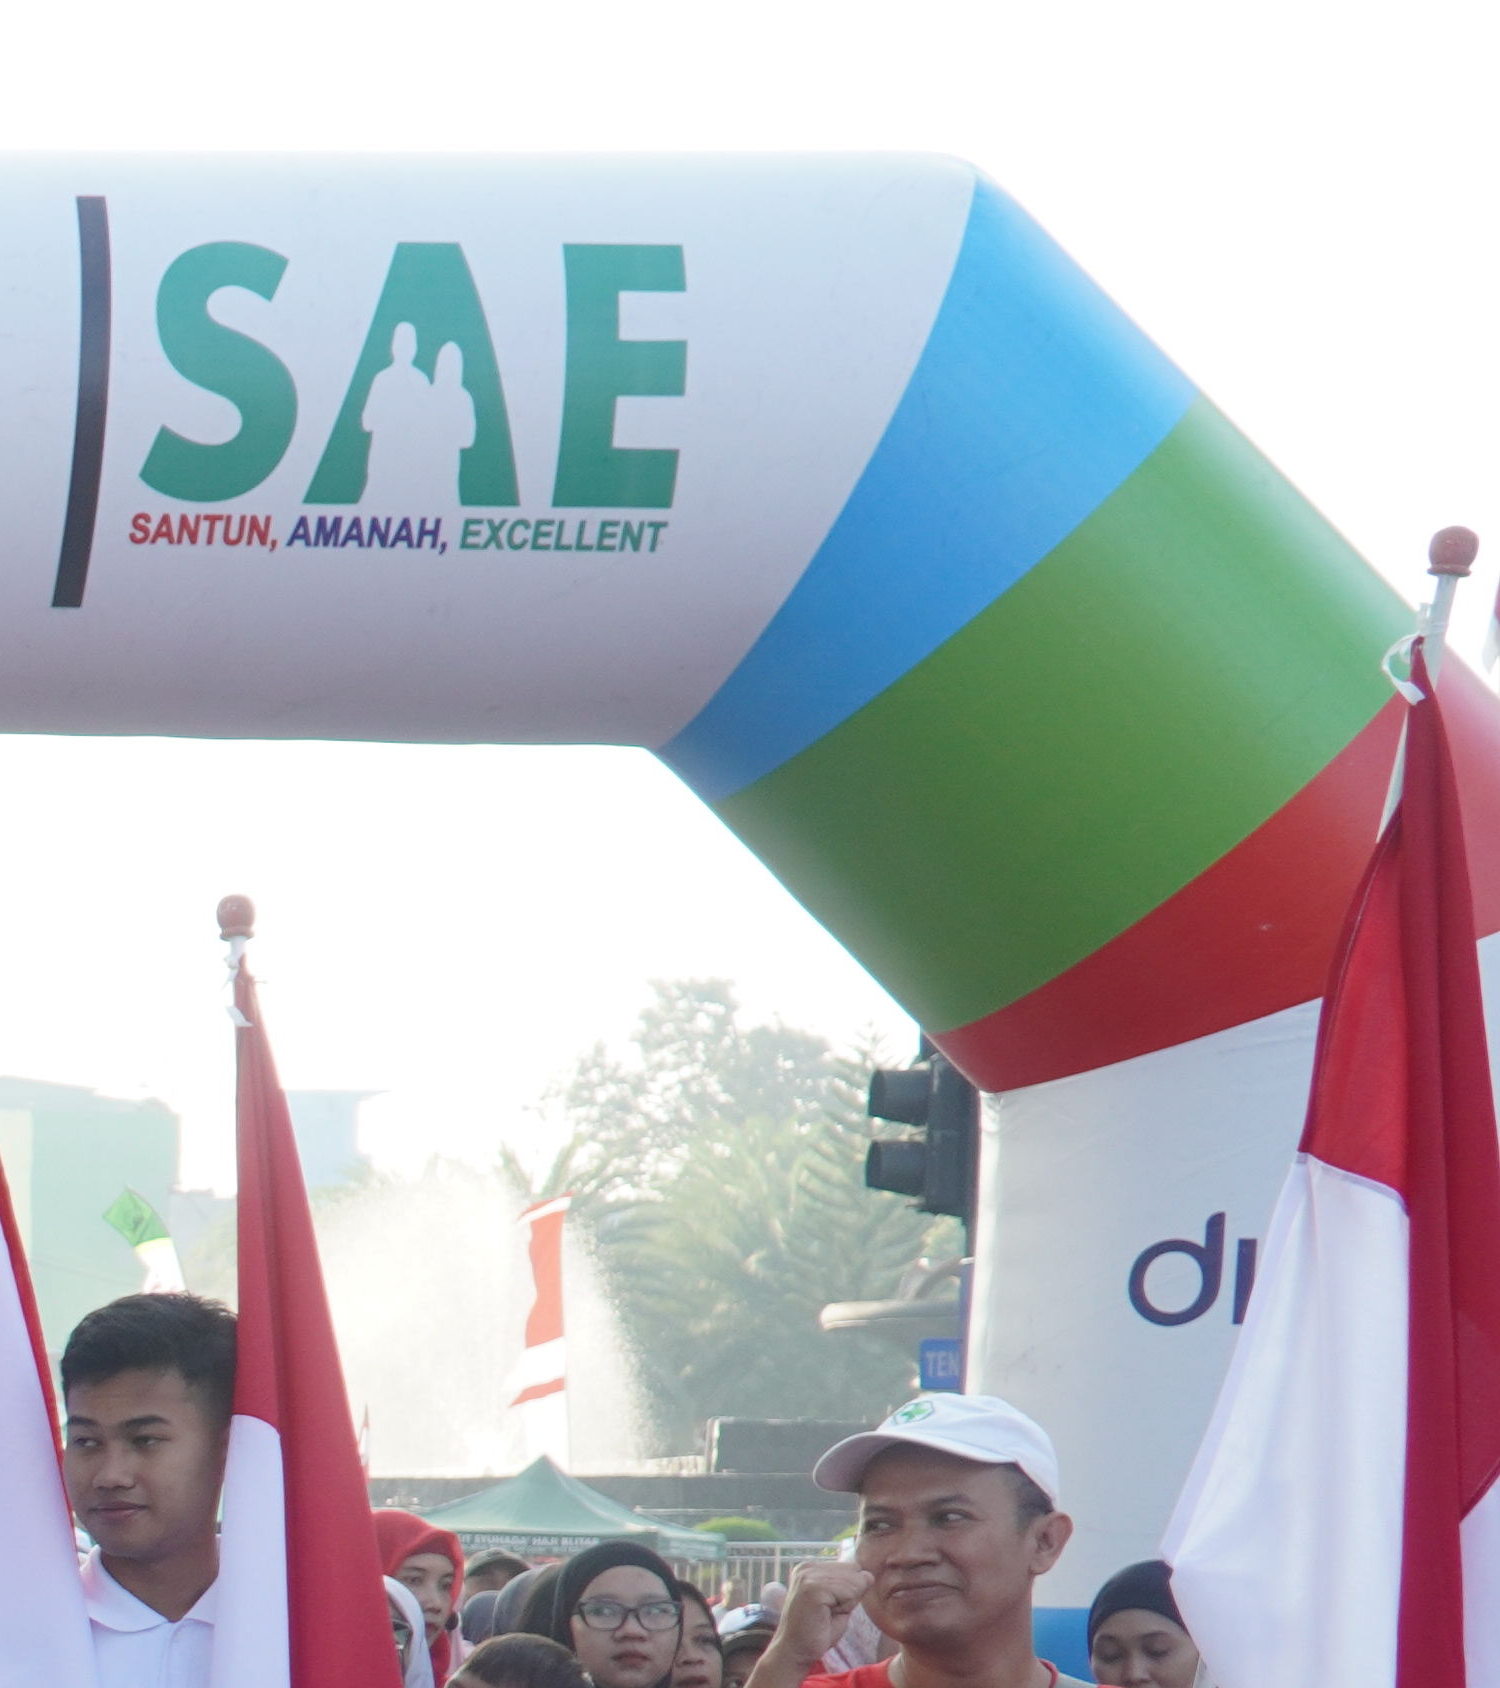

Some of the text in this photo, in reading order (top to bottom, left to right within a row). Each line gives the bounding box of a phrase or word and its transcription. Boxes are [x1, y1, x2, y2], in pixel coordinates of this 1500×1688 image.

[136, 239, 690, 510] SAE
[128, 511, 669, 556] SANTUN, AMANAH, EXCELLENT
